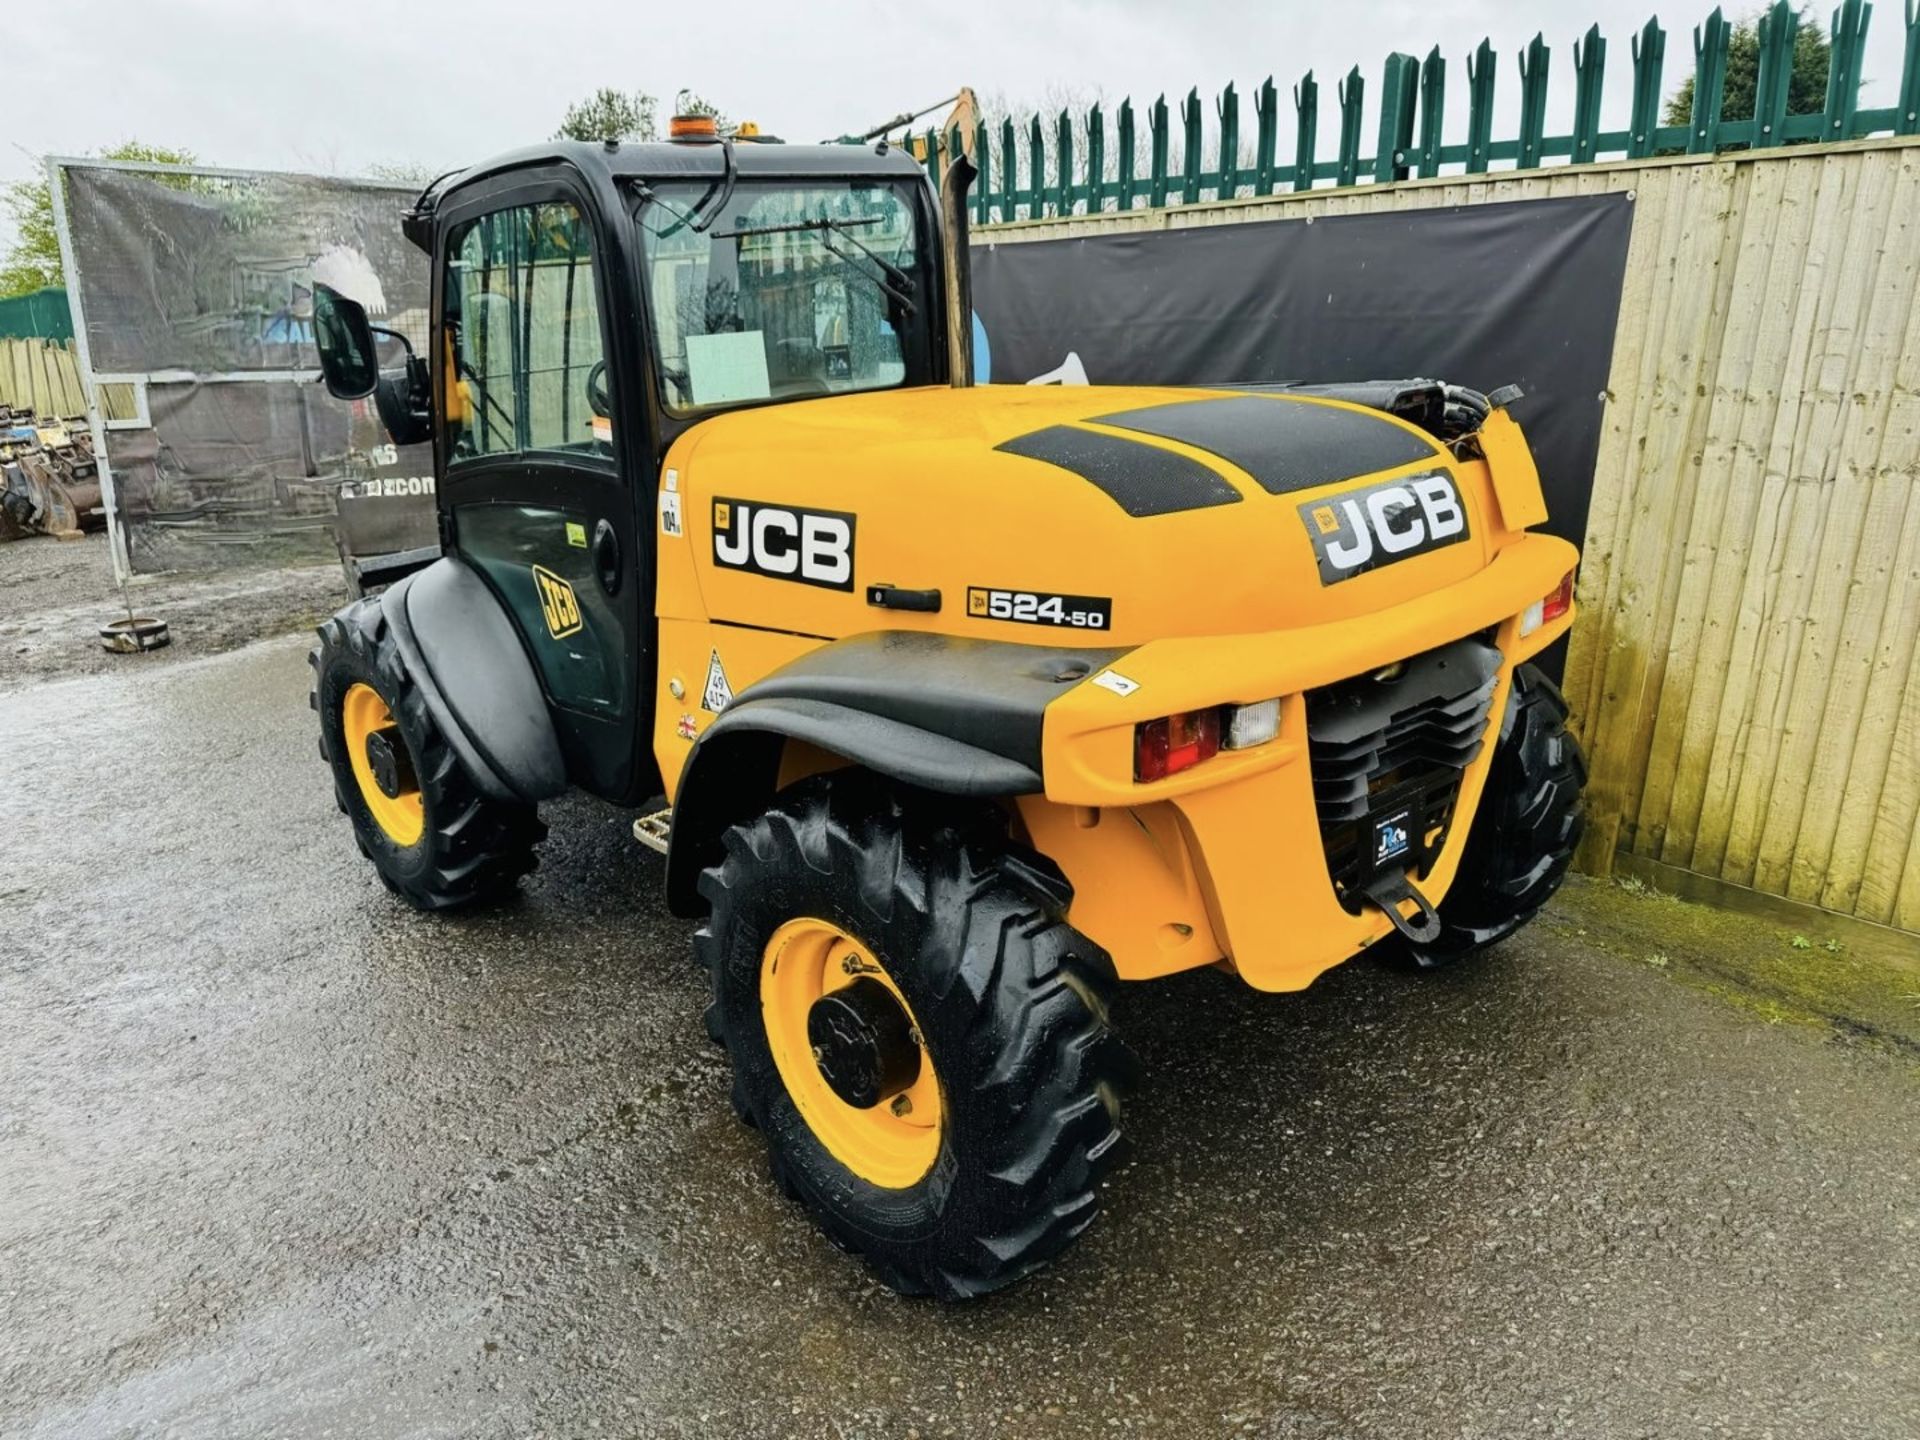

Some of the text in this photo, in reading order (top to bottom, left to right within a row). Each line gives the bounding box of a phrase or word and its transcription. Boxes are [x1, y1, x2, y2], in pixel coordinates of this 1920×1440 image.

[715, 505, 850, 583] JCB
[1325, 476, 1464, 569] JCB
[540, 574, 578, 631] JCB
[989, 591, 1104, 627] 524-50
